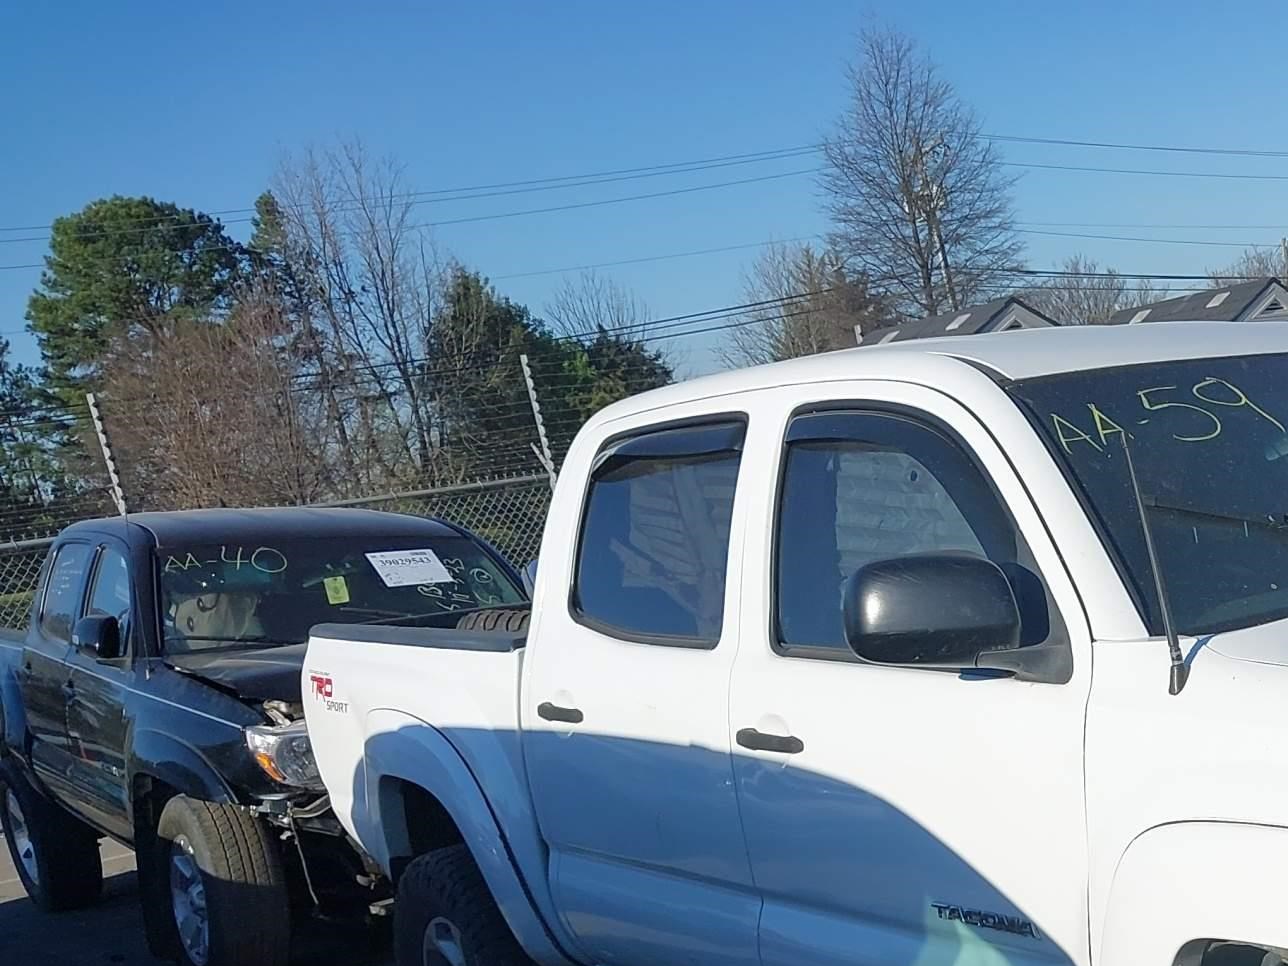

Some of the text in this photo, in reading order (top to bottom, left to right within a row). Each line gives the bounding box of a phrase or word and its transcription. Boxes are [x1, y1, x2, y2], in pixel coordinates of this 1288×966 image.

[1051, 377, 1287, 455] AA-59
[164, 545, 288, 574] AA-40
[378, 557, 432, 567] 39029543
[310, 675, 333, 702] TRD
[326, 700, 348, 713] SPORT
[930, 901, 1042, 941] TACOMA
